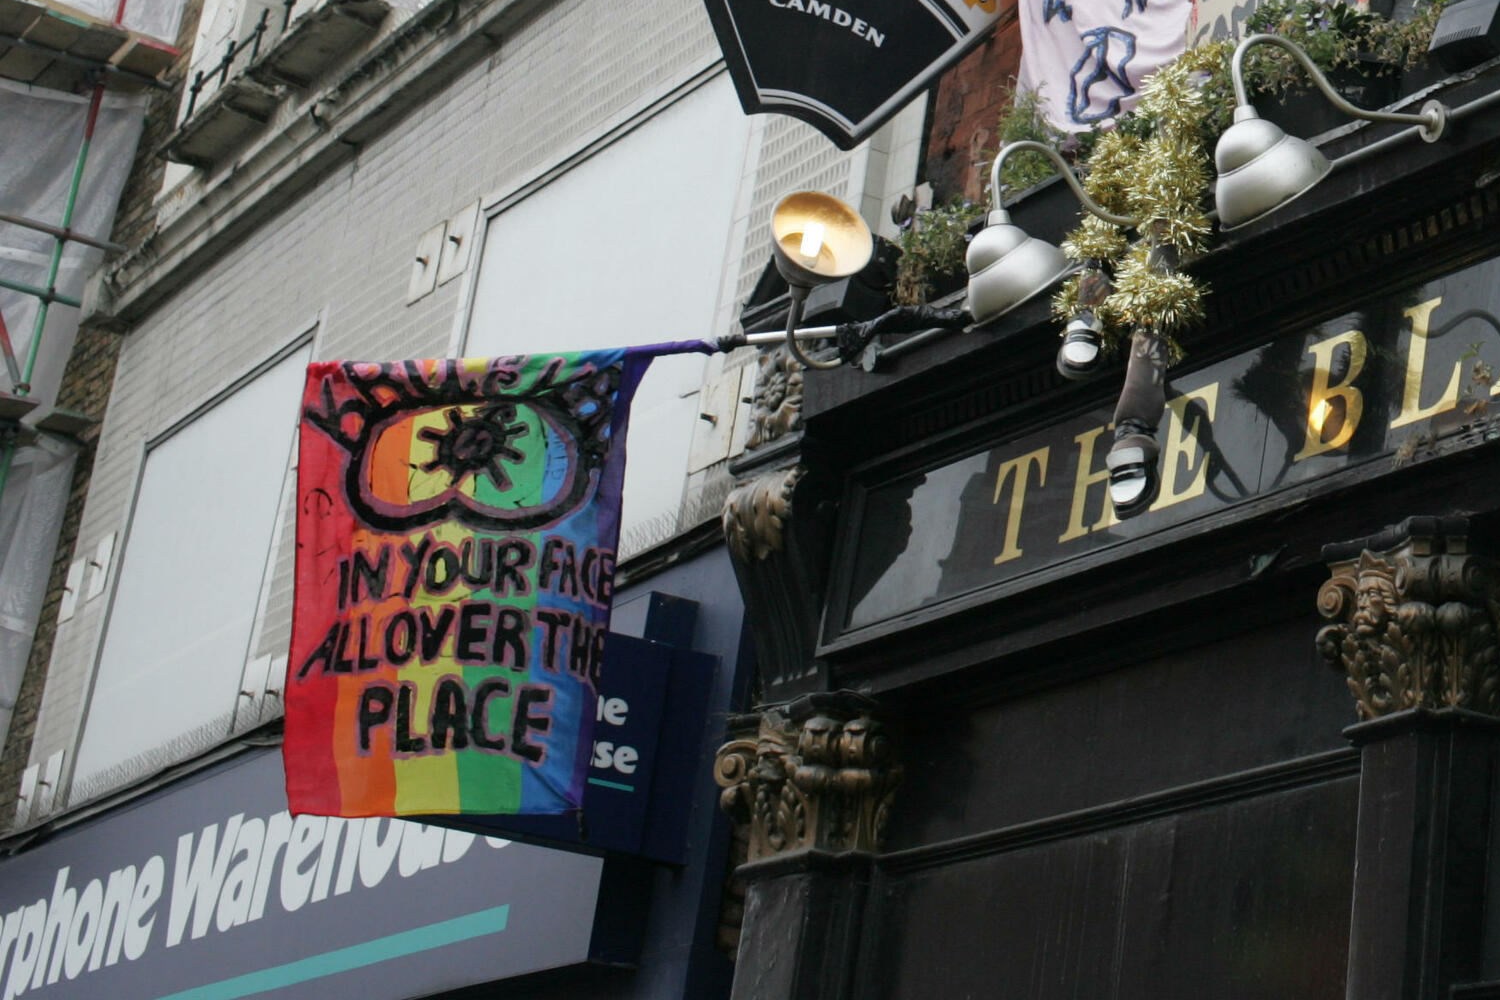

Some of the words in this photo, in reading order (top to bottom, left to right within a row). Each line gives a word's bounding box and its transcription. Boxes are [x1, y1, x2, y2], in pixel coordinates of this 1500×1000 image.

[337, 543, 392, 613] IN
[400, 533, 536, 600] YOUR
[538, 536, 617, 608] FACE
[296, 613, 380, 682] ALL
[384, 601, 532, 672] OVER
[357, 675, 554, 768] PLACE
[0, 855, 165, 1000] rphone
